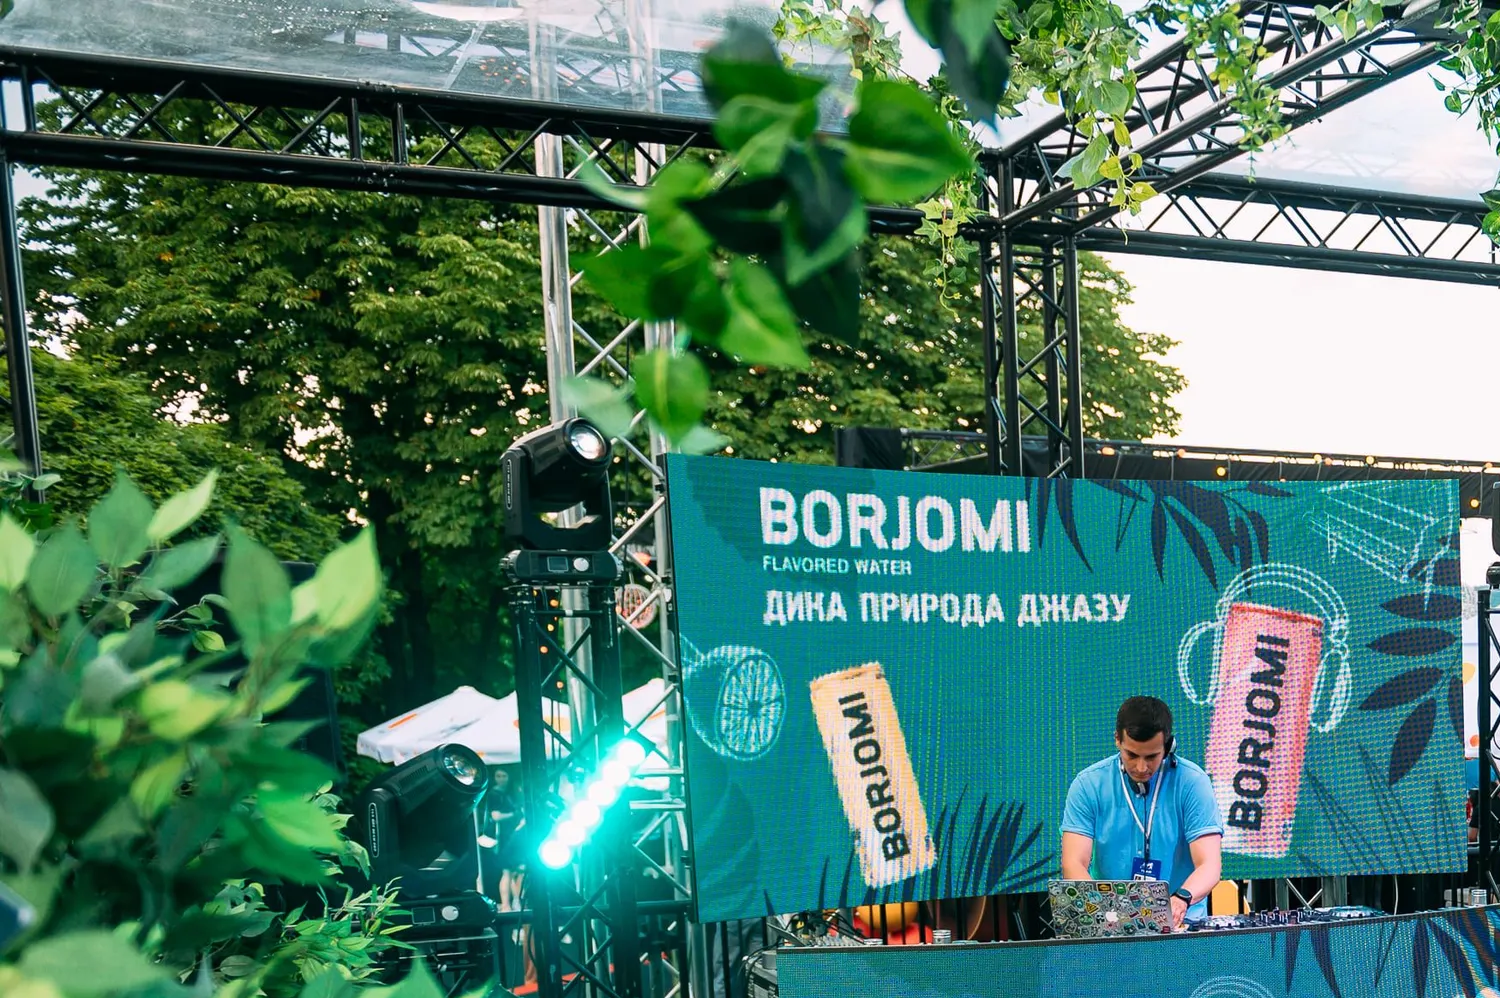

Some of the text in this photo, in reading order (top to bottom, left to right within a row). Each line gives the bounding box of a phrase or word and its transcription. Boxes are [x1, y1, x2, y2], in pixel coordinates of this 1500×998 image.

[759, 487, 1031, 553] BORJOMI
[763, 556, 912, 576] FLAVORED WATER
[763, 590, 1131, 628] ДИКА ПРИРОДА ДЖАЗУ
[1227, 634, 1290, 832] BORJOMI
[838, 692, 910, 862] BORJOMI
